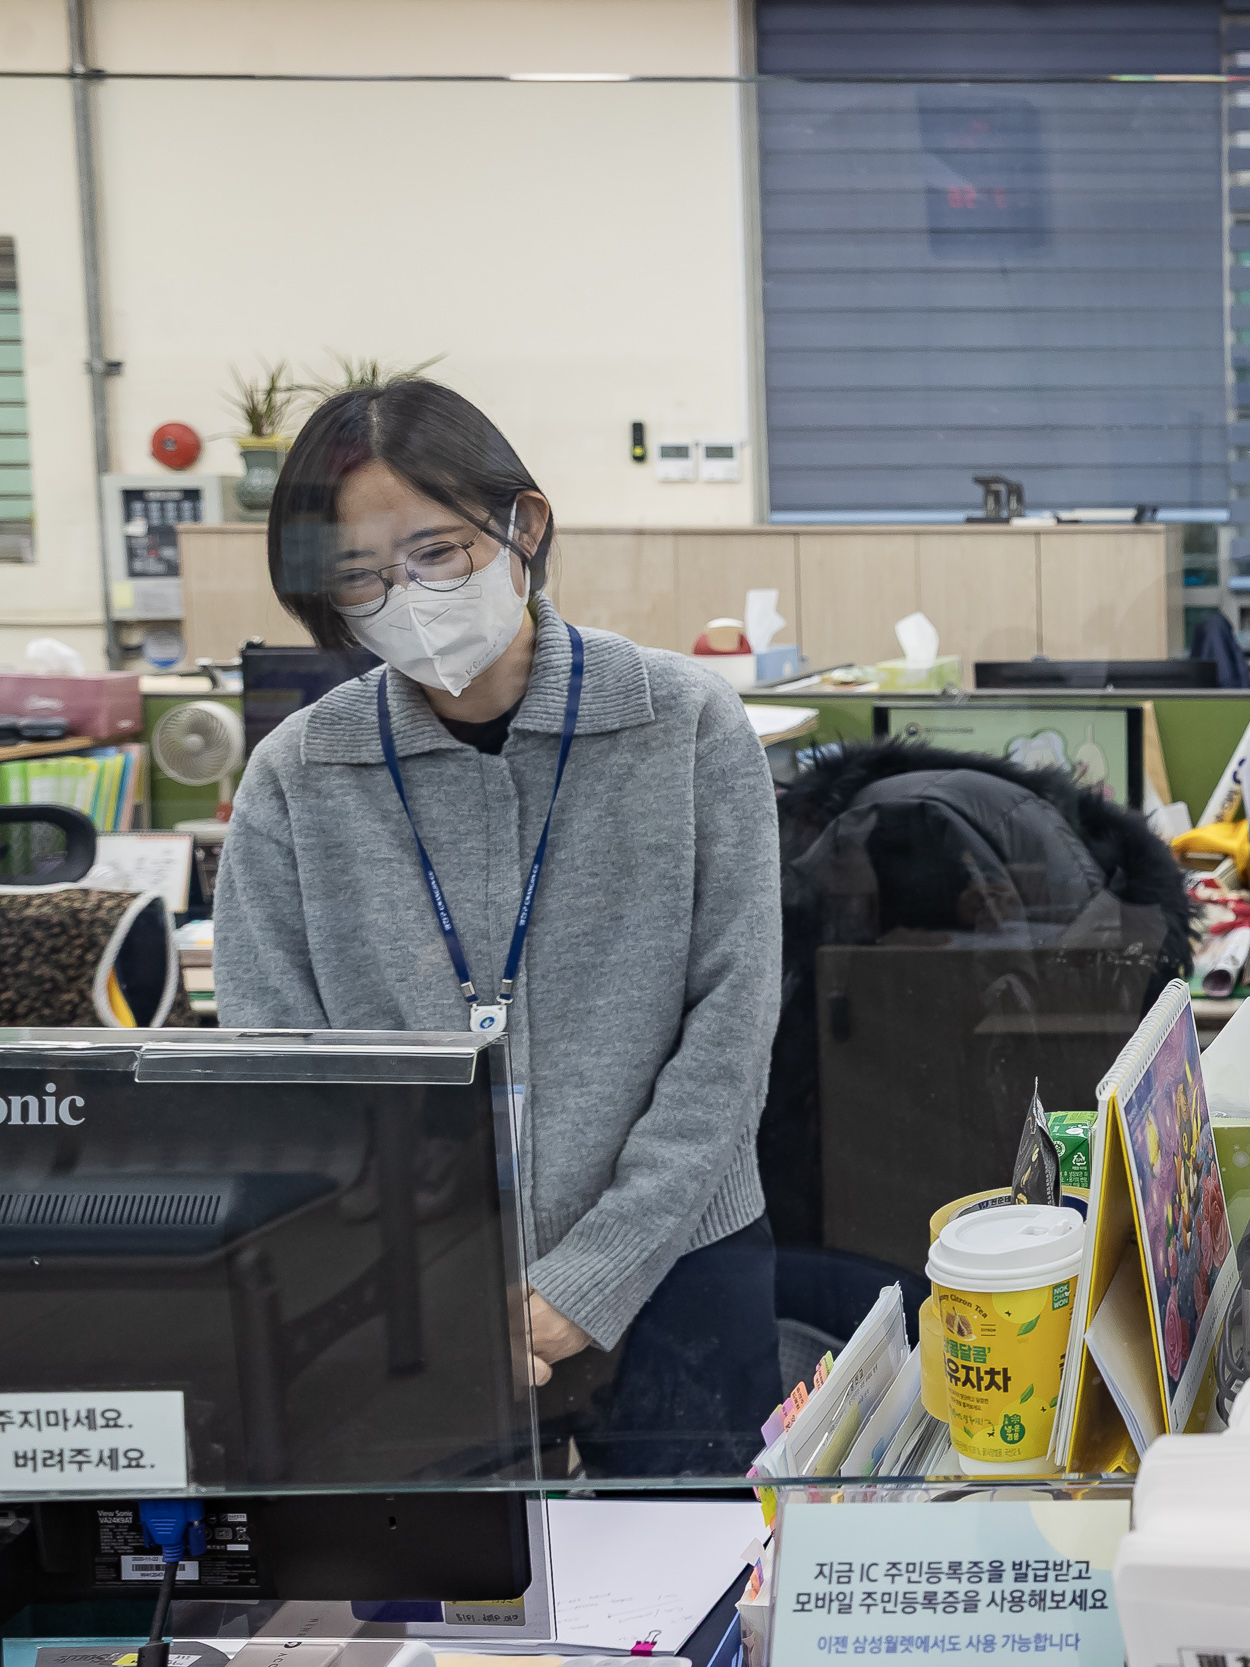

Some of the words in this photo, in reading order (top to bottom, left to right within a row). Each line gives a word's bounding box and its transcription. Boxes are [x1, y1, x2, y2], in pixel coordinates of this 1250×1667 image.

[0, 1083, 85, 1125] nic
[950, 1294, 973, 1308] Citron
[974, 1304, 988, 1319] Tea
[943, 1352, 1012, 1393] 유자차
[13, 1448, 156, 1473] 버려주세요.
[814, 1562, 854, 1584] 지금
[859, 1563, 879, 1583] IC
[884, 1560, 1006, 1585] 주민등록증을
[1011, 1560, 1092, 1584] 발급받고
[792, 1591, 854, 1615] 모바일
[859, 1590, 982, 1615] 주민등록증을
[986, 1589, 1109, 1613] 사용해보세요
[817, 1635, 849, 1654] 이젠
[853, 1634, 962, 1654] 삼성월렛에서도
[965, 1633, 998, 1652] 사용
[1001, 1632, 1081, 1652] 가능합니다
